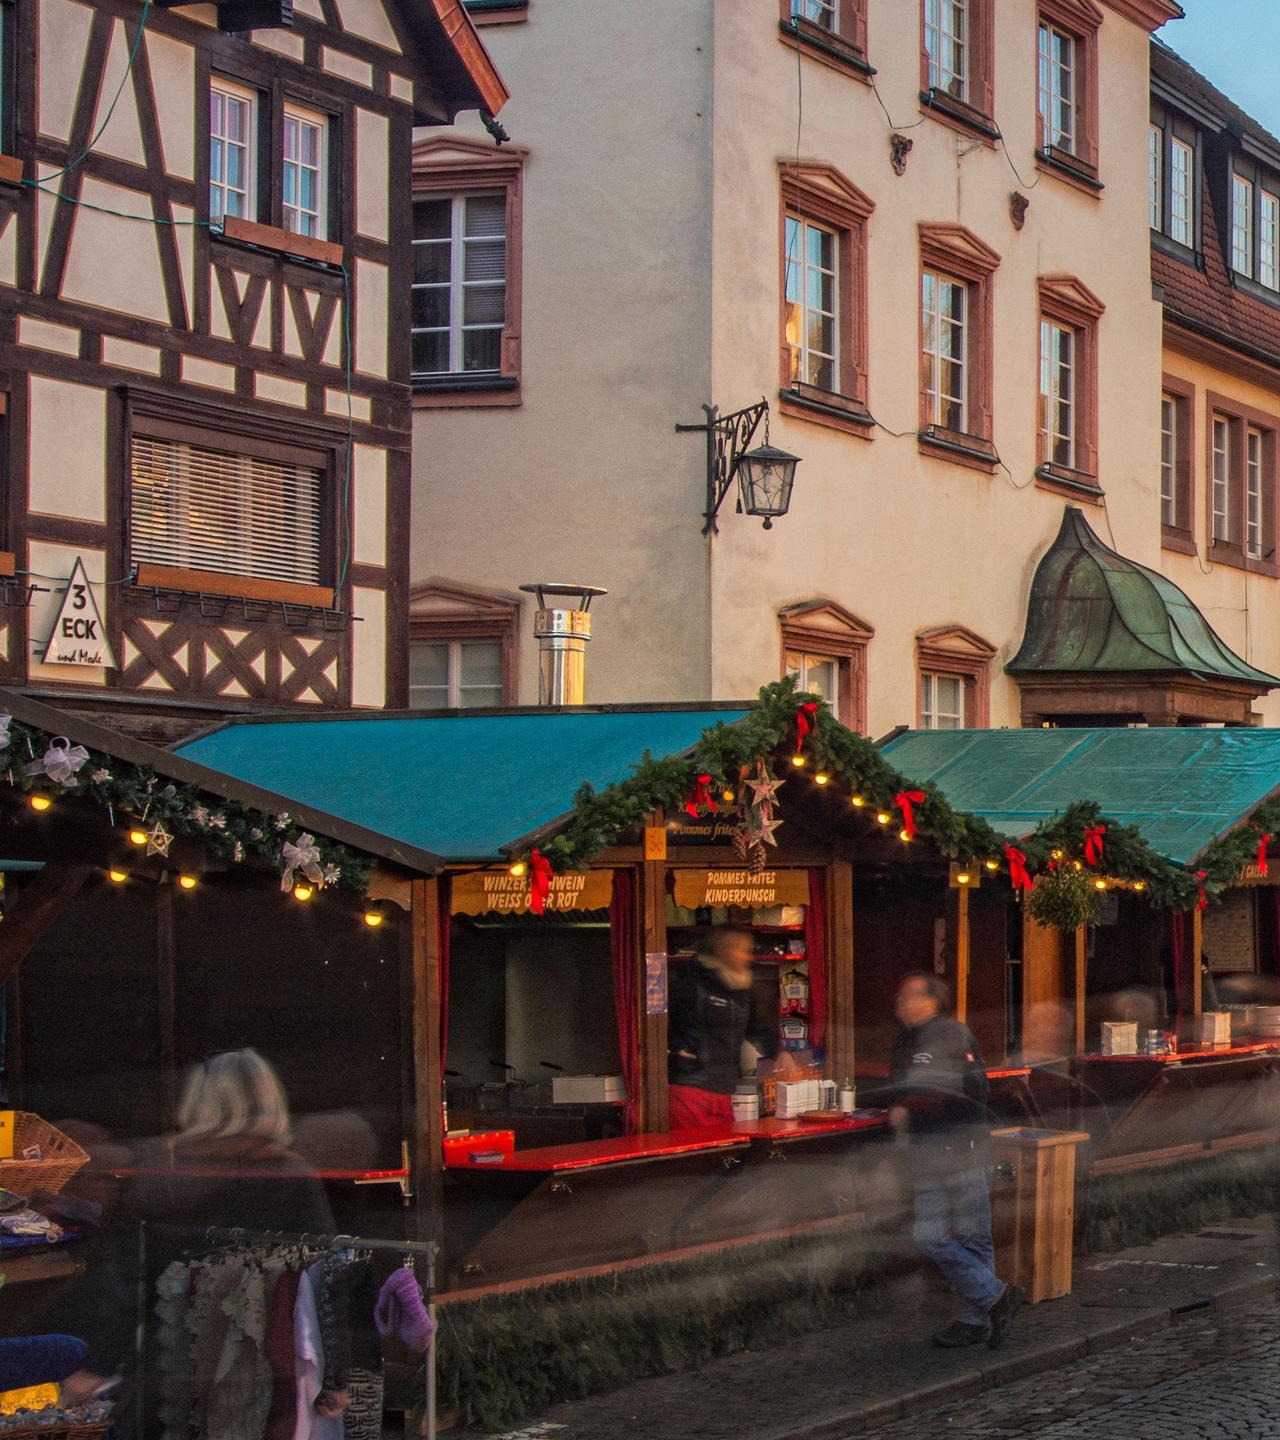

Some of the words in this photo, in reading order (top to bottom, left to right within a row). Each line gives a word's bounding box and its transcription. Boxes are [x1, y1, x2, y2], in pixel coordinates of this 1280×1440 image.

[72, 584, 87, 610] 3
[62, 617, 97, 640] ECK
[79, 648, 102, 664] Mode
[707, 872, 745, 885] POMMES
[747, 872, 776, 885] FRITES
[487, 892, 522, 908] WEISS
[524, 892, 554, 908] OER
[556, 891, 580, 908] ROT
[705, 889, 776, 902] KINDERPUNSCH
